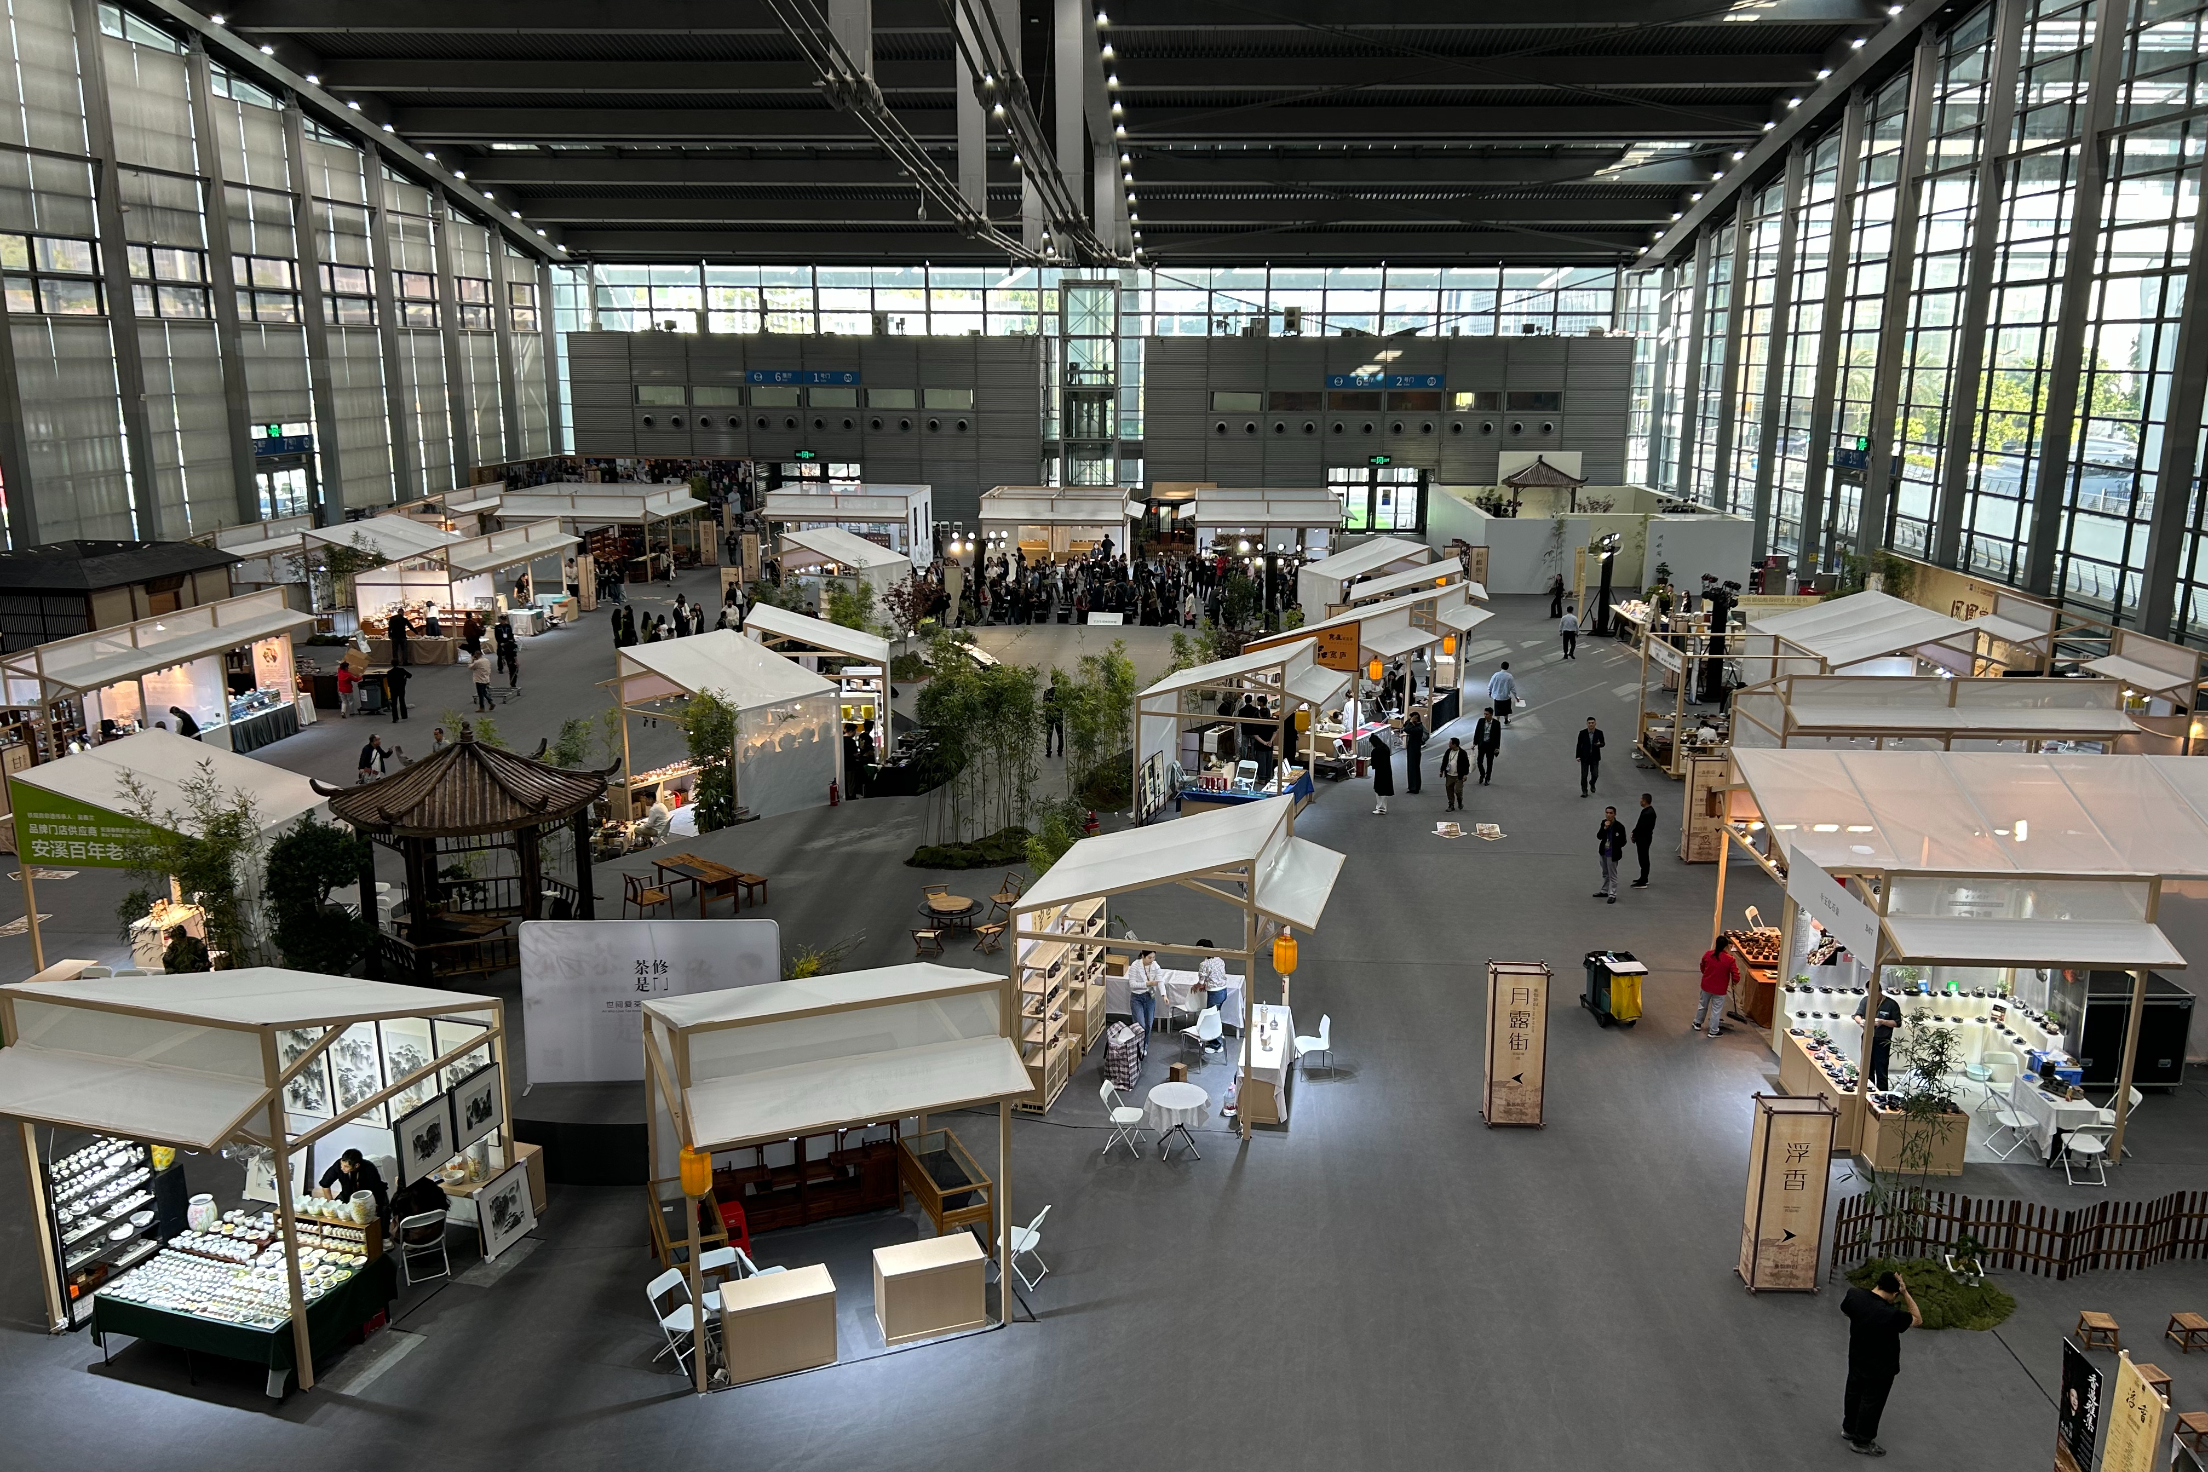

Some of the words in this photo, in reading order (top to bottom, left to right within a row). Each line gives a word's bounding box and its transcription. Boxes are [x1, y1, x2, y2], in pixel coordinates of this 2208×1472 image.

[29, 823, 98, 837] 品牌门店供应商
[31, 838, 161, 863] 安溪百年老
[1509, 987, 1531, 1051] 月露街
[1782, 1142, 1811, 1191] 浮香
